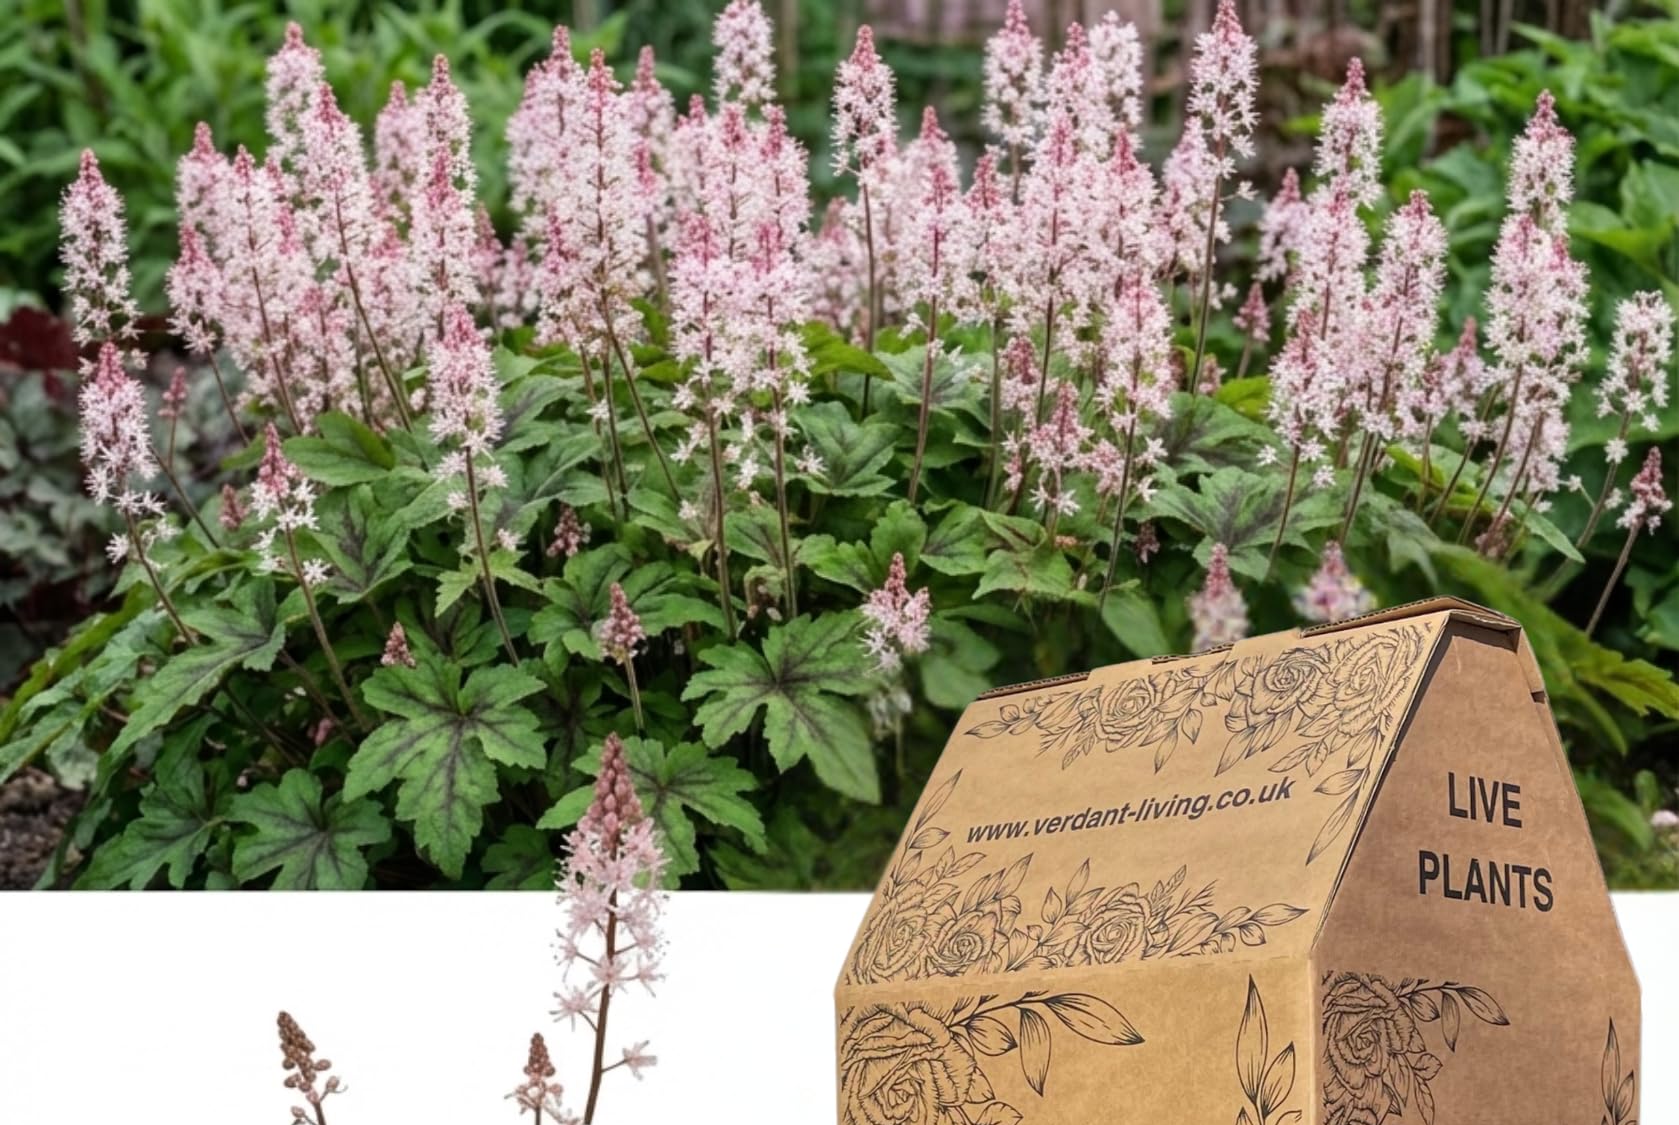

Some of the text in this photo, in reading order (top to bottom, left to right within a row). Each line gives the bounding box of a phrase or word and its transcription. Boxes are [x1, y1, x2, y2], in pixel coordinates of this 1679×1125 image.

[966, 776, 1296, 843] www.verdant-living.co.uk
[1448, 771, 1522, 828] LIVE
[1418, 850, 1554, 912] PLANTS
